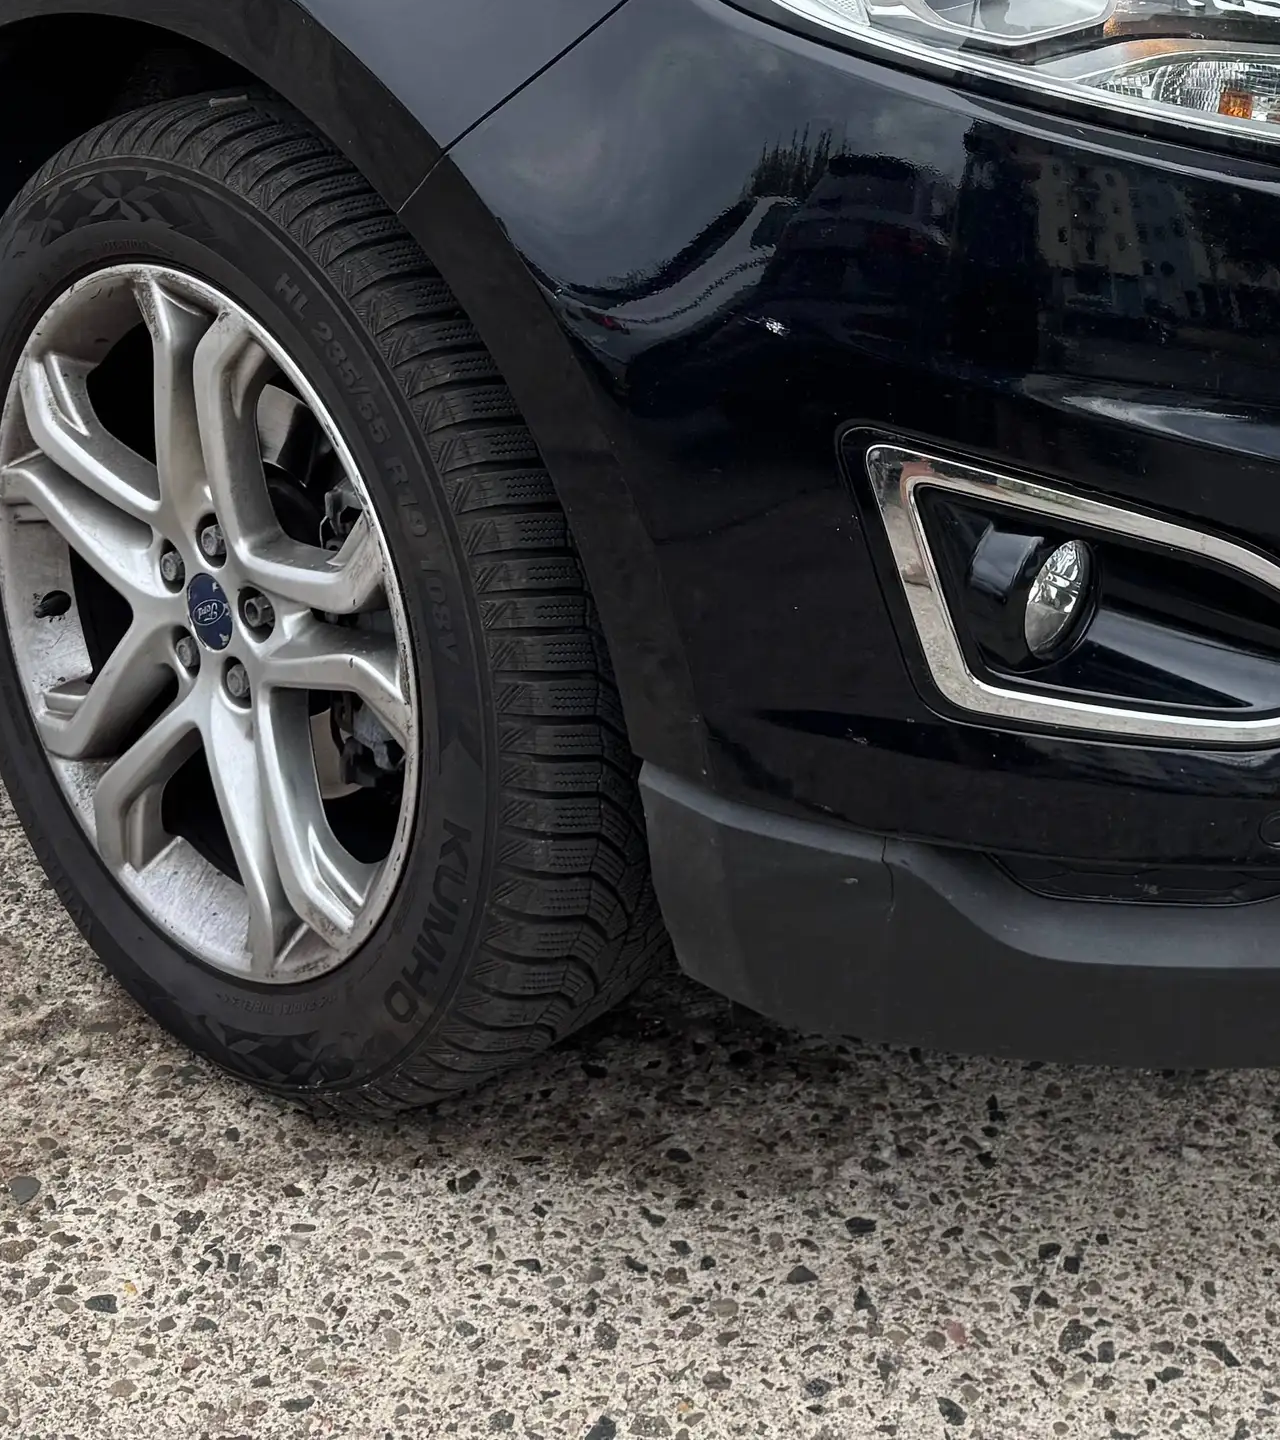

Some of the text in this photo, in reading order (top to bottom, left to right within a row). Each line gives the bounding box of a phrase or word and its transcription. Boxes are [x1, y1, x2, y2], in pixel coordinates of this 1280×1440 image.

[274, 272, 312, 321] HL
[311, 321, 392, 444] 235/55
[384, 456, 429, 538] R19
[196, 601, 219, 623] Ford
[383, 818, 473, 1024] KUMHO
